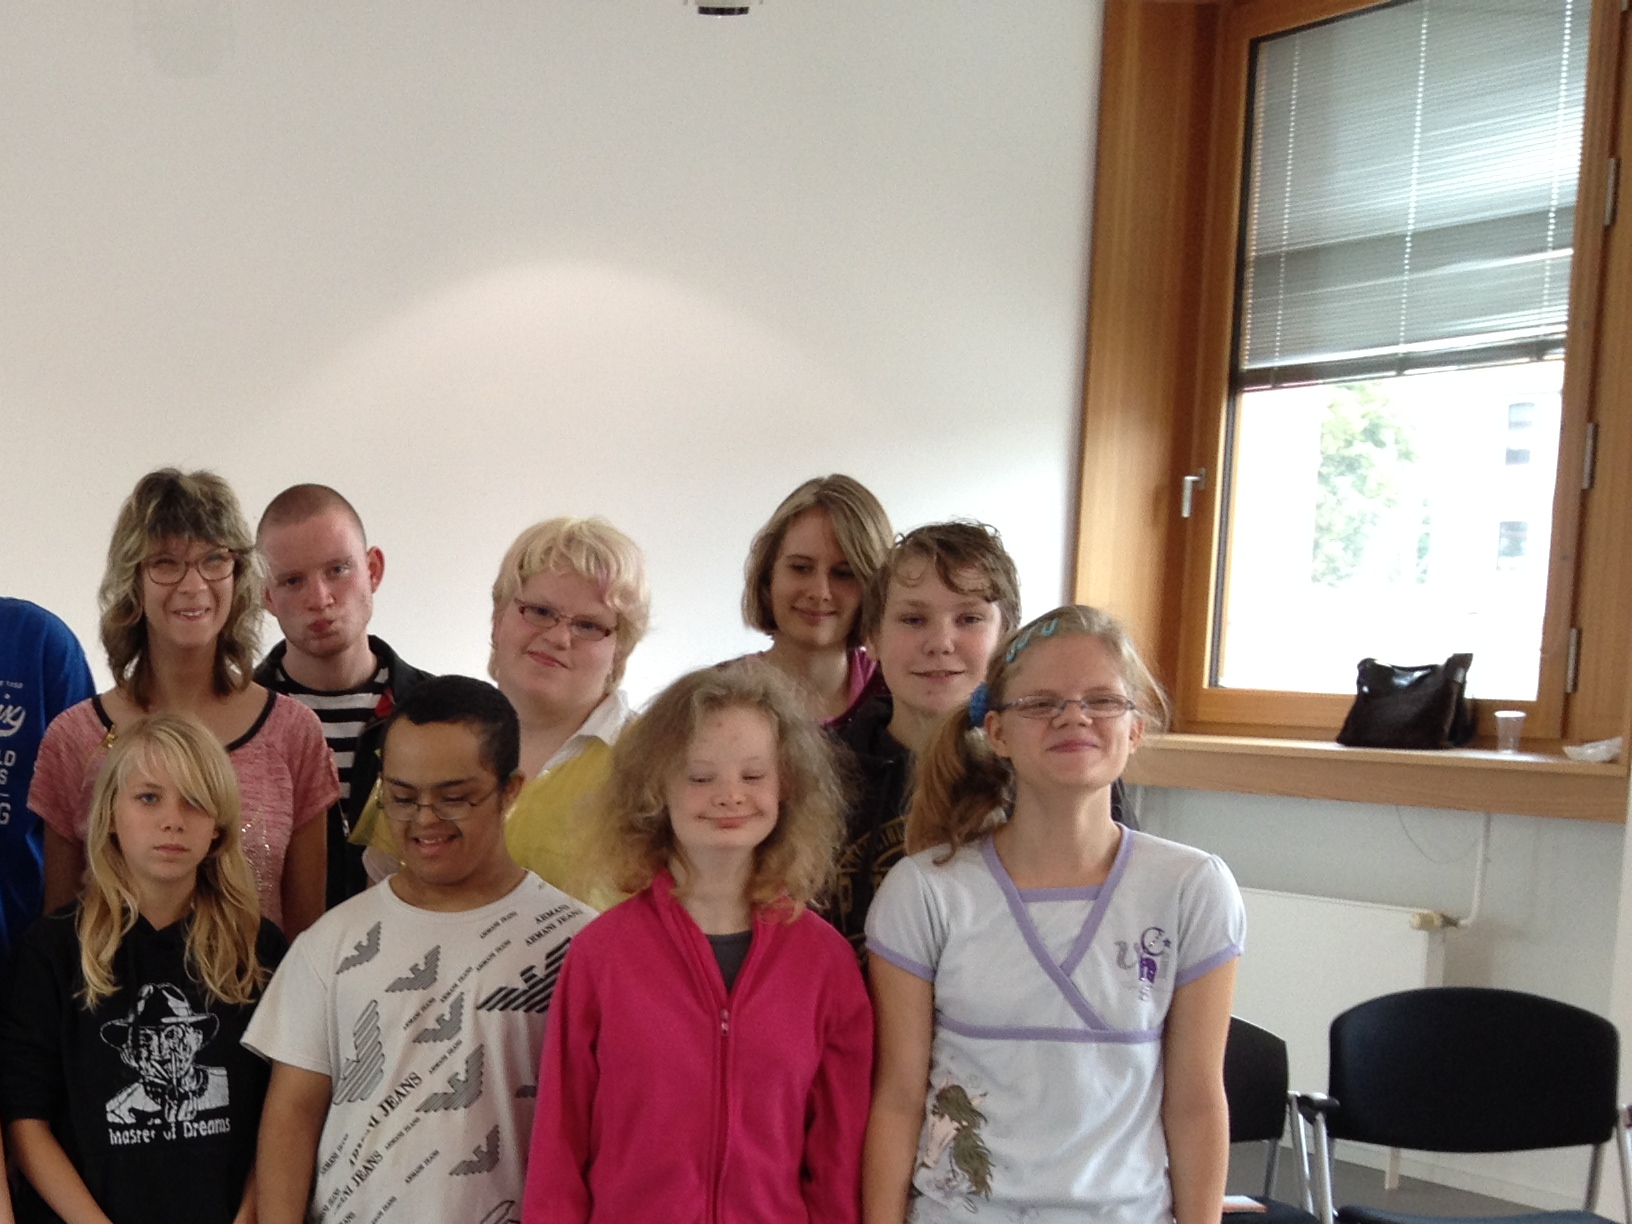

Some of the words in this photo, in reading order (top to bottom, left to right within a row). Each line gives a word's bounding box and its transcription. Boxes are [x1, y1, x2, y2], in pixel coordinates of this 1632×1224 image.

[534, 904, 571, 924] ARMANI
[524, 923, 557, 947] ARMANI
[378, 1071, 423, 1118] JEANS
[108, 1128, 156, 1145] Master
[183, 1117, 231, 1138] Dreams
[350, 1150, 384, 1188] JEANS
